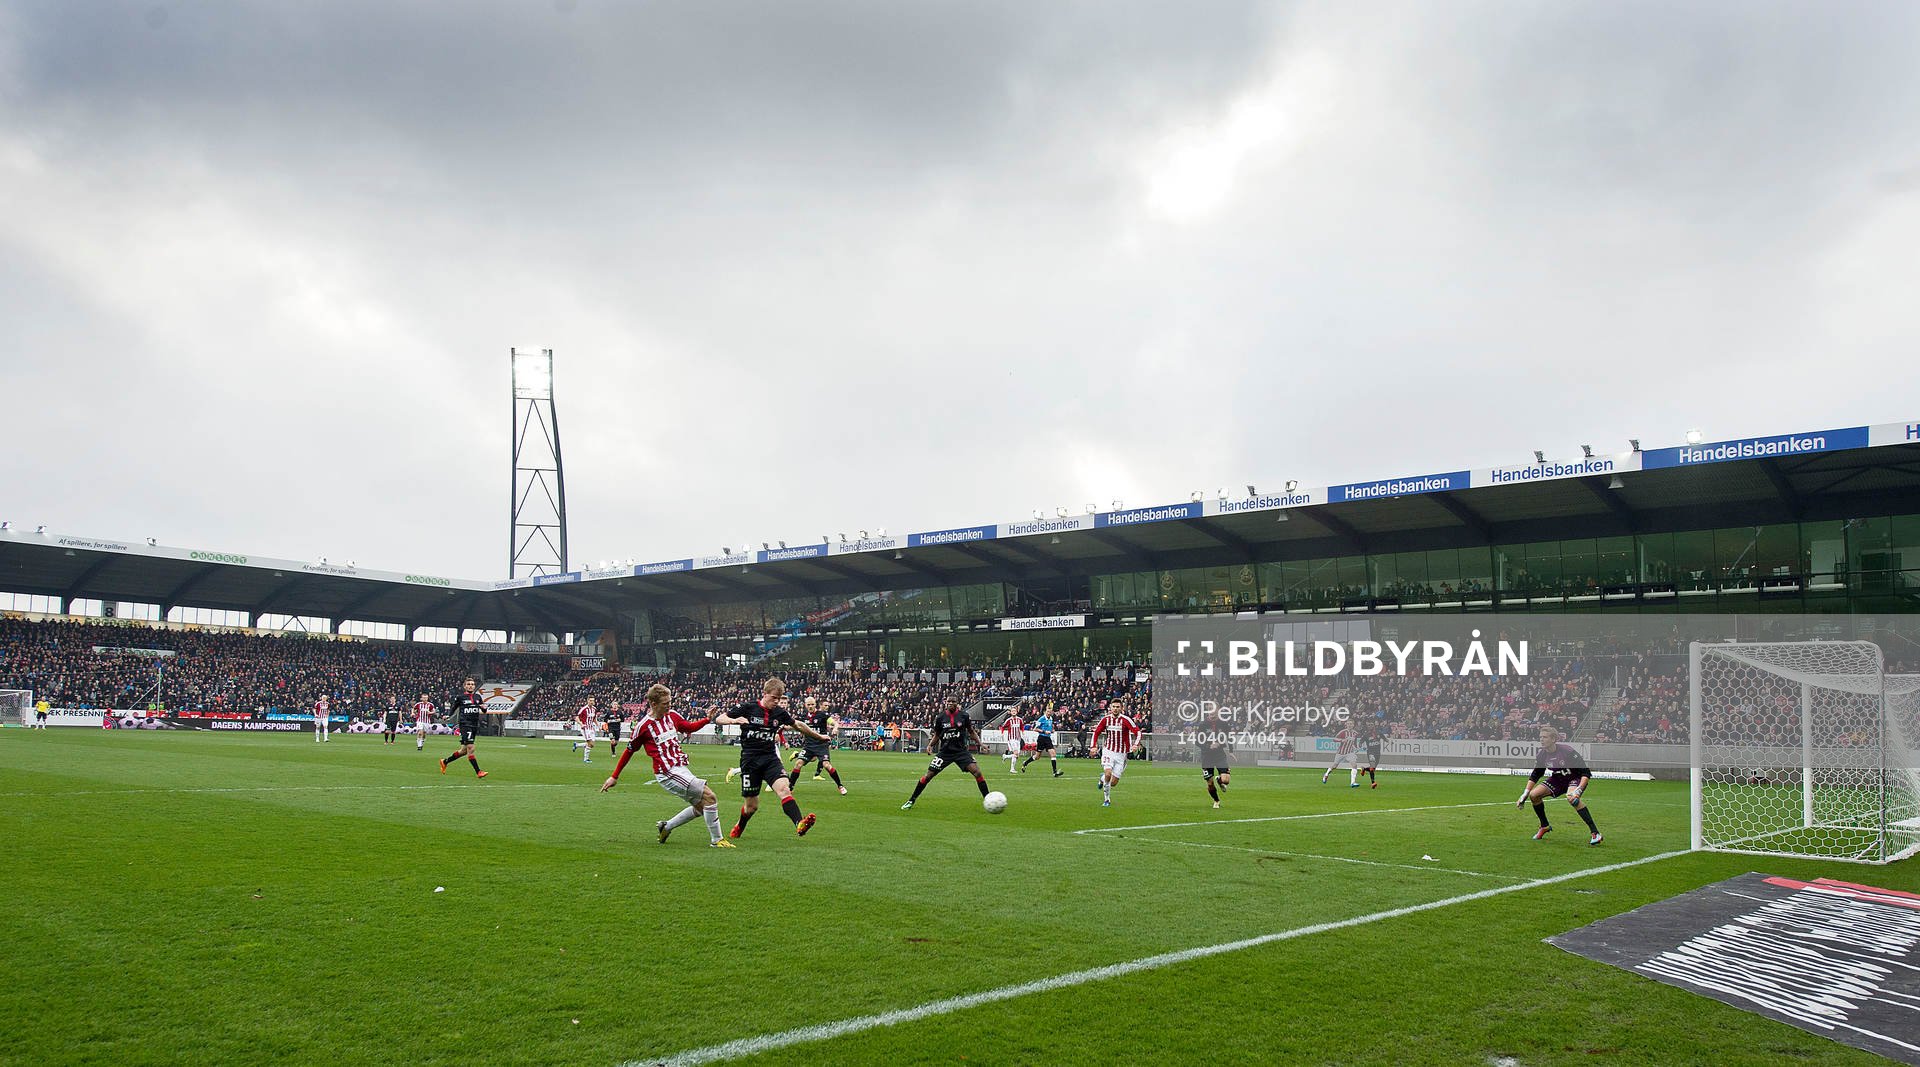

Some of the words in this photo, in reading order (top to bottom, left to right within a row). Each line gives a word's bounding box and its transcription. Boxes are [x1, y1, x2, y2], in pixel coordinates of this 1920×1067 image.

[1679, 436, 1825, 464] Handelsbanken
[1491, 459, 1613, 483] Handelsbanken
[1344, 475, 1450, 500] Handelsbanken
[1219, 493, 1310, 513] Handelsbanken
[1107, 505, 1188, 525] Handelsbanken
[1008, 518, 1080, 535] Handelsbanken
[920, 527, 983, 545] Handelsbanken
[839, 538, 896, 553] Handelsbanken
[767, 547, 818, 560] Handelsbanken
[642, 562, 684, 574] Handelsbanken
[702, 555, 748, 568] Handelsbanken
[1010, 617, 1074, 629] Handelsbanken
[580, 660, 602, 669] STARK
[212, 721, 243, 729] DAGENS
[244, 722, 301, 731] KAMPSPONSOR
[467, 731, 473, 739] 7
[1479, 741, 1501, 757] i'm
[932, 755, 944, 767] 20
